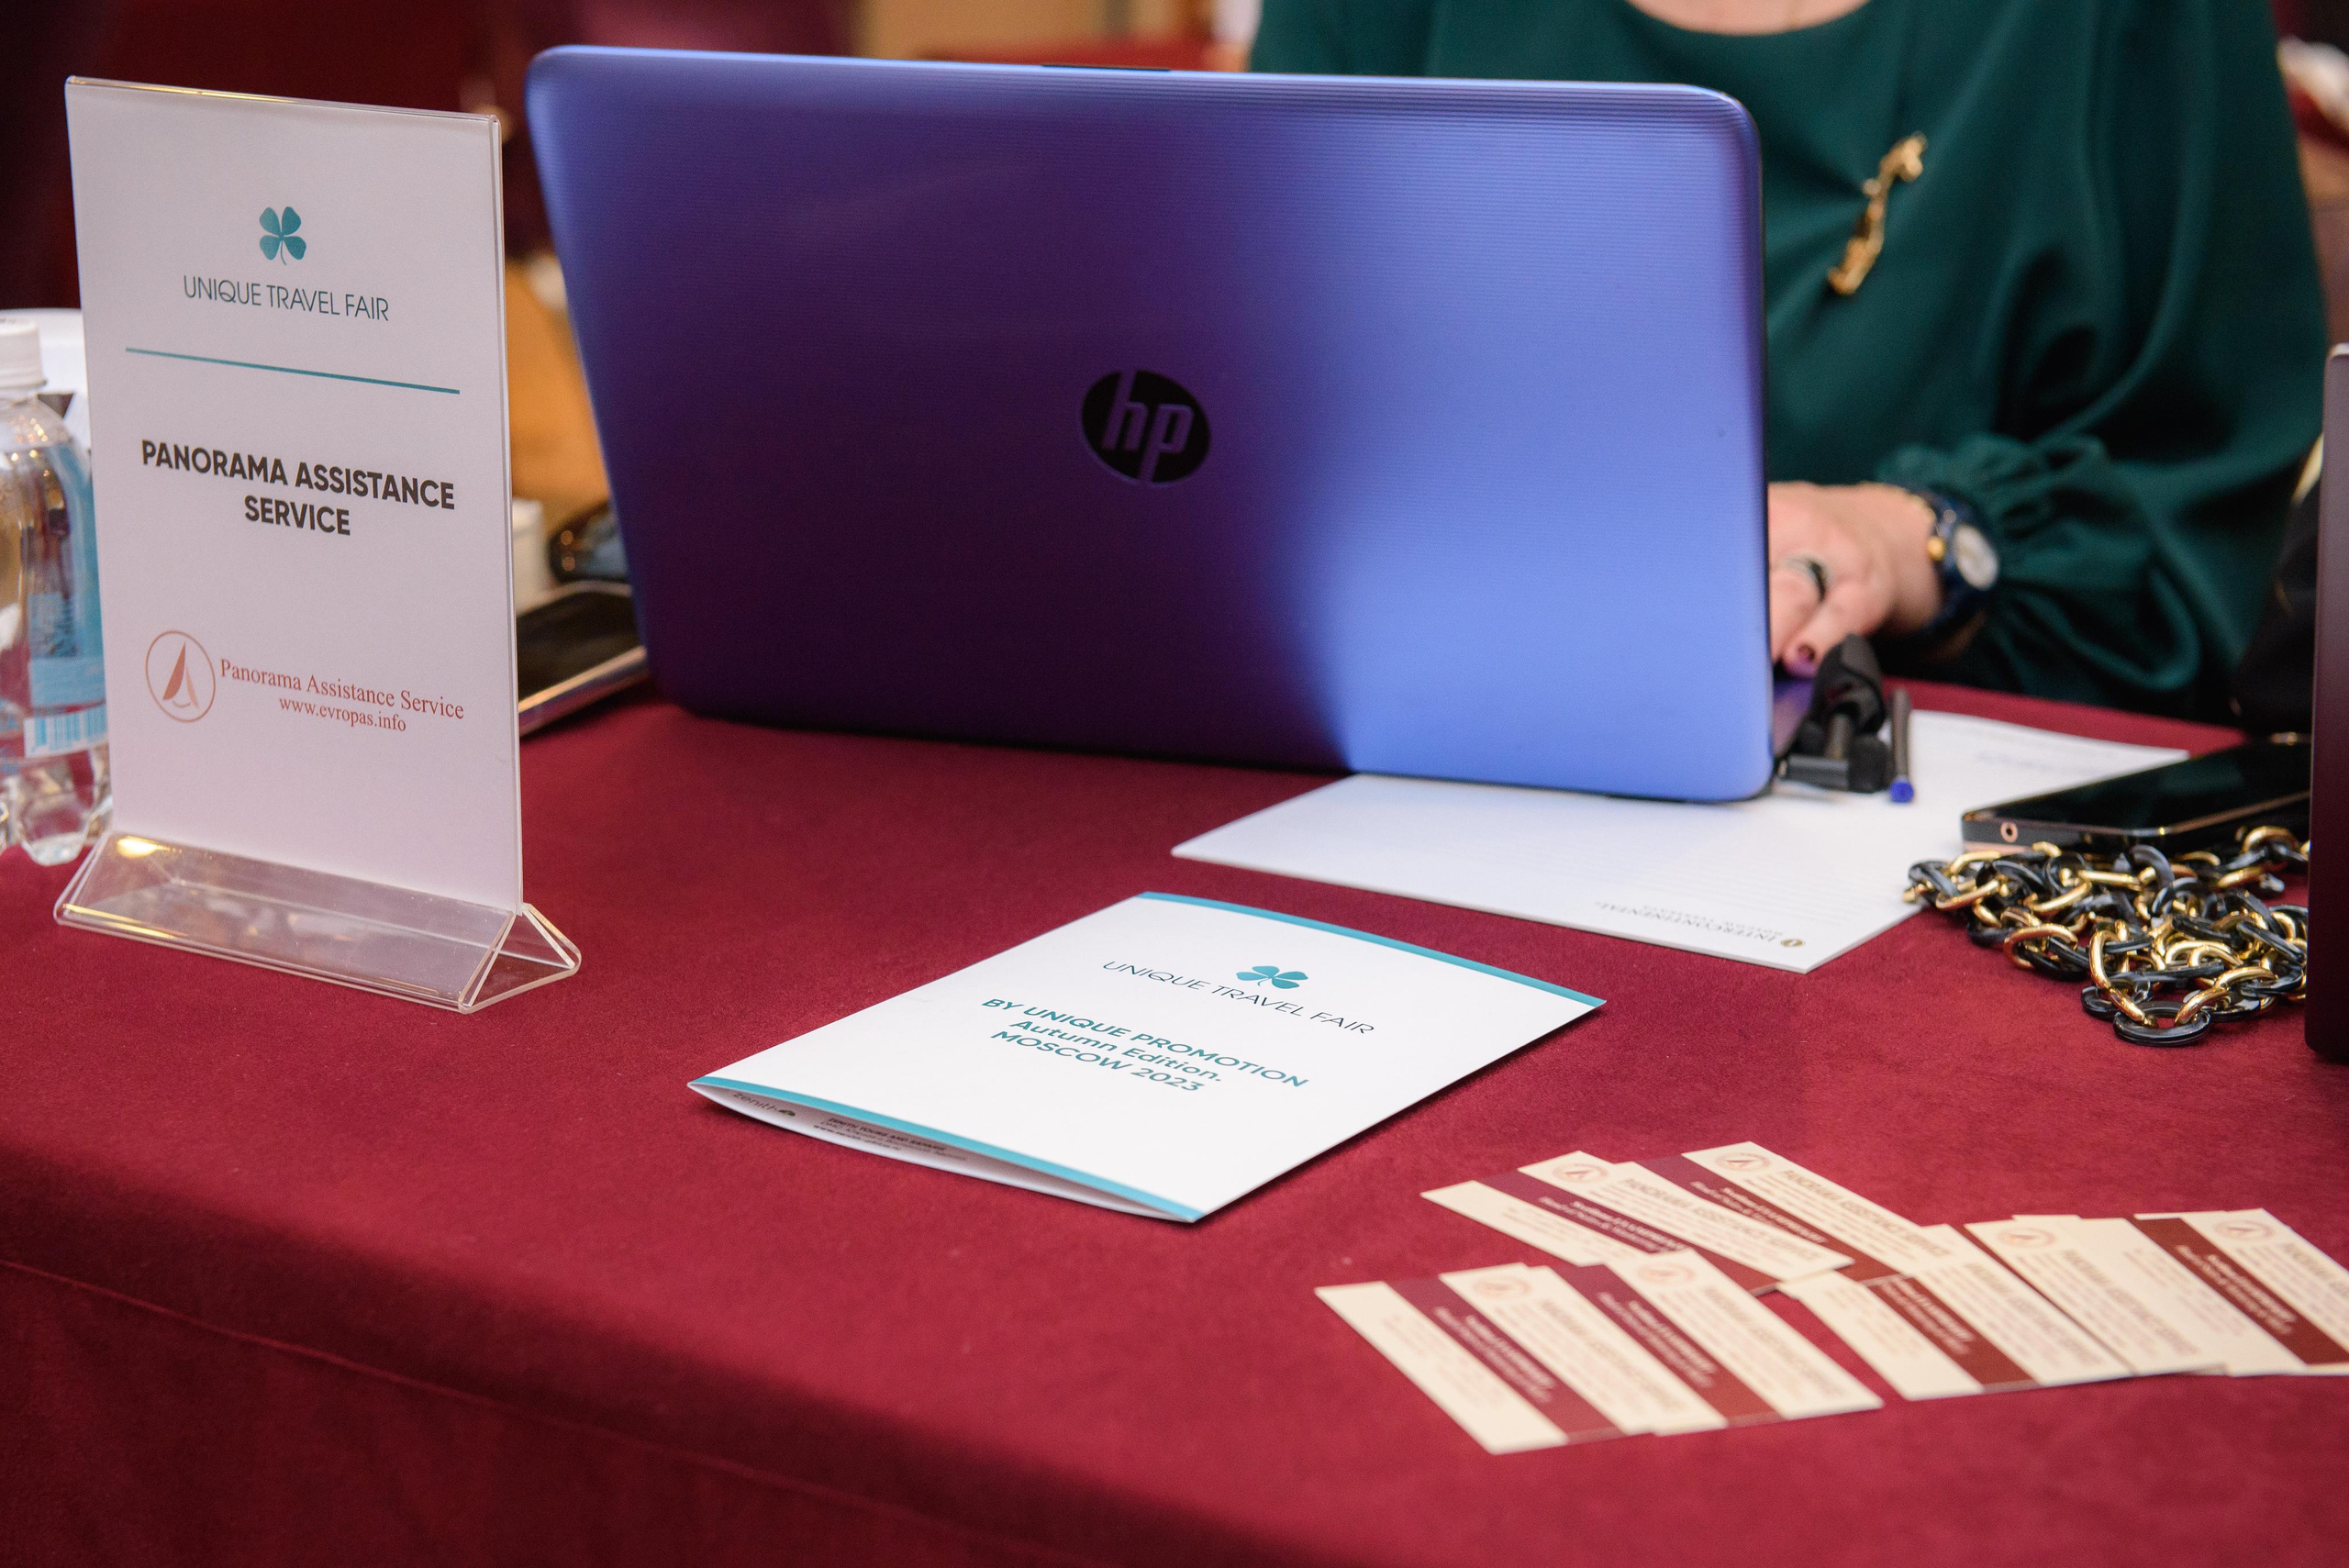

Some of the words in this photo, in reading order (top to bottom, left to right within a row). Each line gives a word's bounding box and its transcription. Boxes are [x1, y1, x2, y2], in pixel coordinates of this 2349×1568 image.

[184, 275, 262, 306] UNIQUE
[266, 284, 340, 316] TRAVEL
[345, 294, 389, 321] FAIR
[1099, 369, 1195, 484] hp
[141, 439, 287, 486] PANORAMA
[295, 462, 455, 510] ASSISTANCE
[243, 495, 351, 536] SERVICE
[220, 658, 302, 691] Panorama
[306, 674, 395, 707] Assistance
[400, 690, 465, 720] Service
[278, 695, 406, 732] www.evropas.info
[1102, 961, 1210, 990] UNIQUE
[1211, 984, 1305, 1017] TRAVEL
[1308, 1011, 1375, 1036] FAIR
[981, 997, 1023, 1011] BY
[1023, 1006, 1134, 1039] UNIQUE
[1132, 1032, 1309, 1088] PROMOTION
[990, 1030, 1134, 1072] MOSCOW
[1130, 1067, 1205, 1092] 2023
[1009, 1019, 1118, 1052] Autumn
